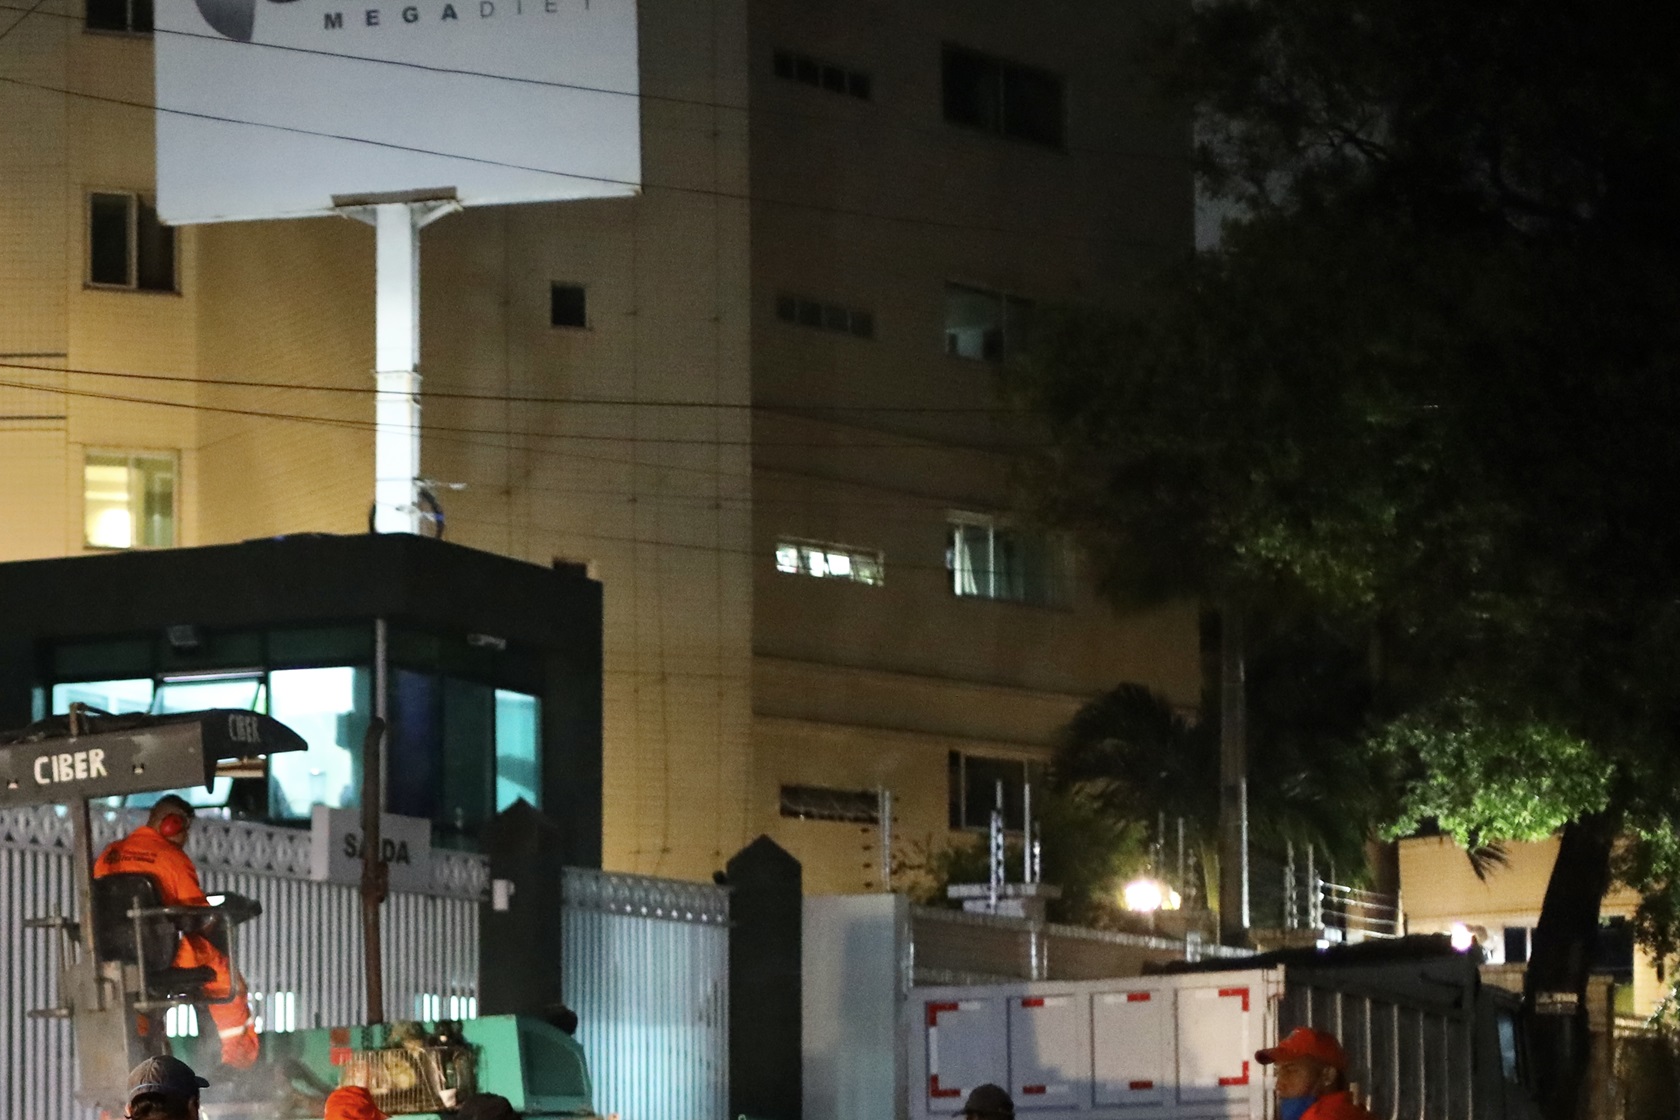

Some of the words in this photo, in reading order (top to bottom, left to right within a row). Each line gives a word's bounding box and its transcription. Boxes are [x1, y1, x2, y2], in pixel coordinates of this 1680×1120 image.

[228, 713, 262, 743] CIBER
[33, 748, 108, 785] CIBER
[343, 832, 410, 865] SDA
